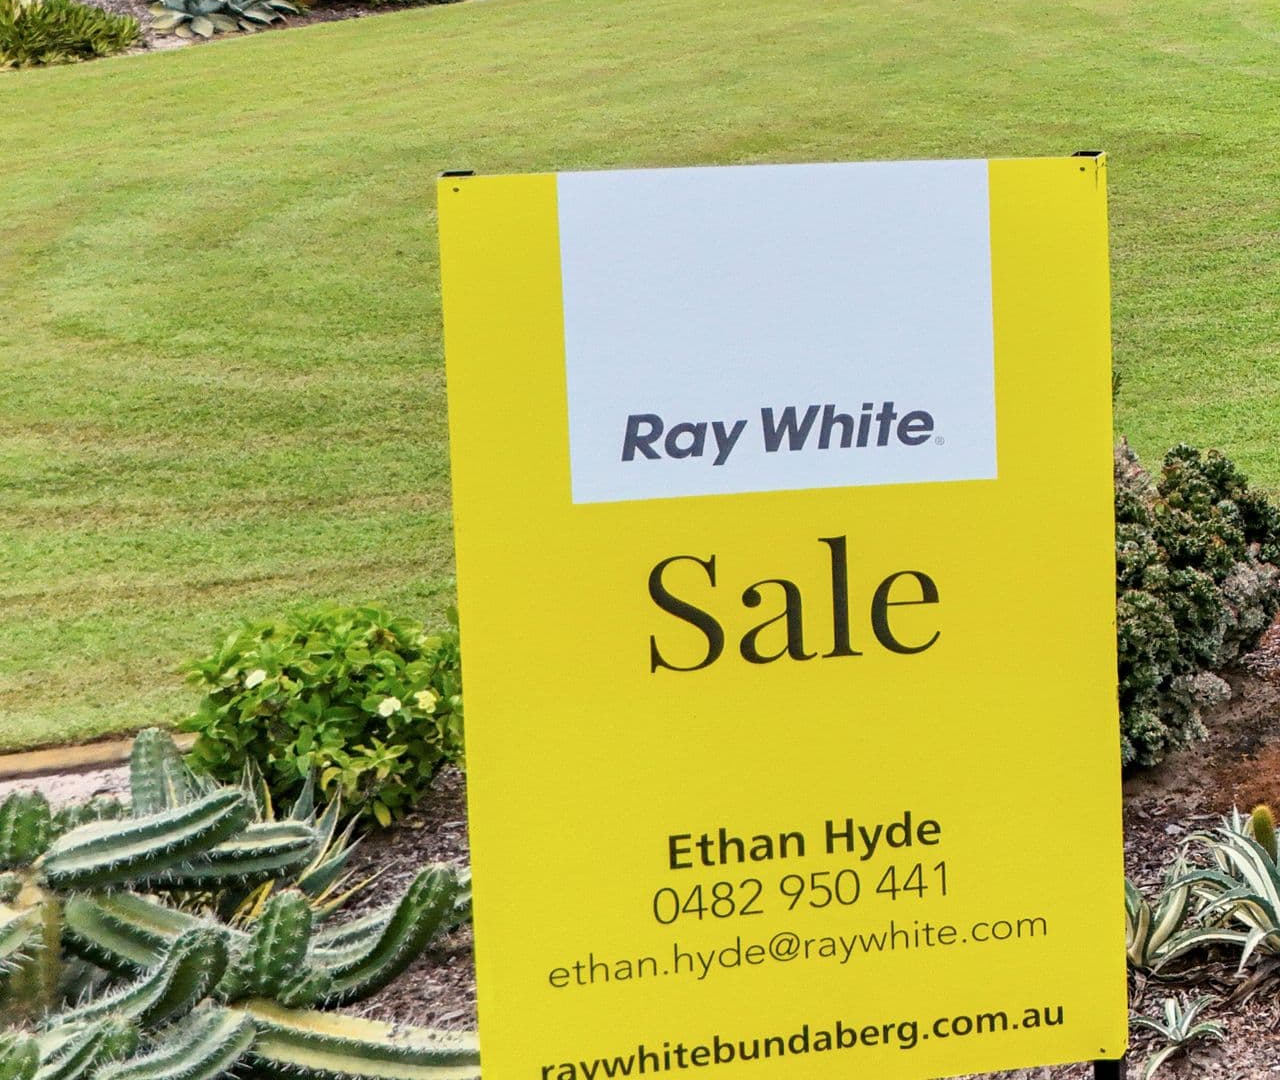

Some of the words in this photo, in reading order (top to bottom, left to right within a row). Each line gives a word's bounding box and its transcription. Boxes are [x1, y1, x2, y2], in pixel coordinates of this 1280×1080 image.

[621, 413, 748, 467] Ray
[760, 400, 936, 453] White
[647, 534, 941, 674] Sale
[668, 826, 806, 871] Ethan
[824, 810, 942, 862] Hyde
[652, 878, 765, 925] 0482
[779, 868, 862, 911] 950
[875, 860, 949, 901] 441
[548, 915, 1048, 989] ethan.hyde@raywhite.com
[541, 1004, 1065, 1080] raywhitebundaberg.com.au
